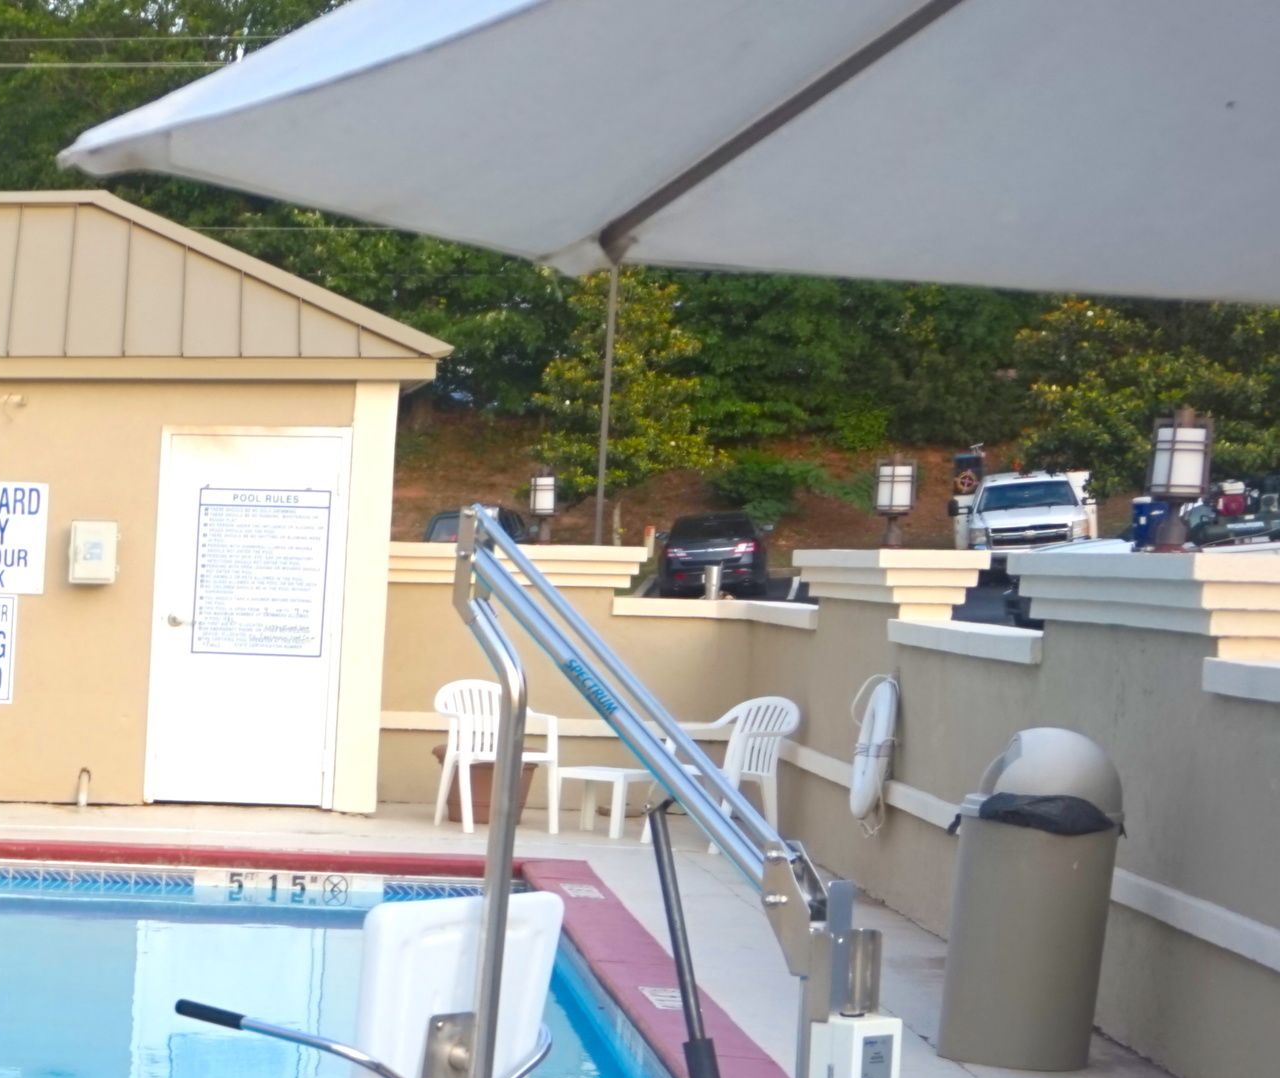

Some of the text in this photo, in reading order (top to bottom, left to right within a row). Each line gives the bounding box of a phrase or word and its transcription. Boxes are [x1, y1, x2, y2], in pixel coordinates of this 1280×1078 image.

[232, 493, 300, 504] POOL RULES
[566, 658, 619, 714] SPECTRUM
